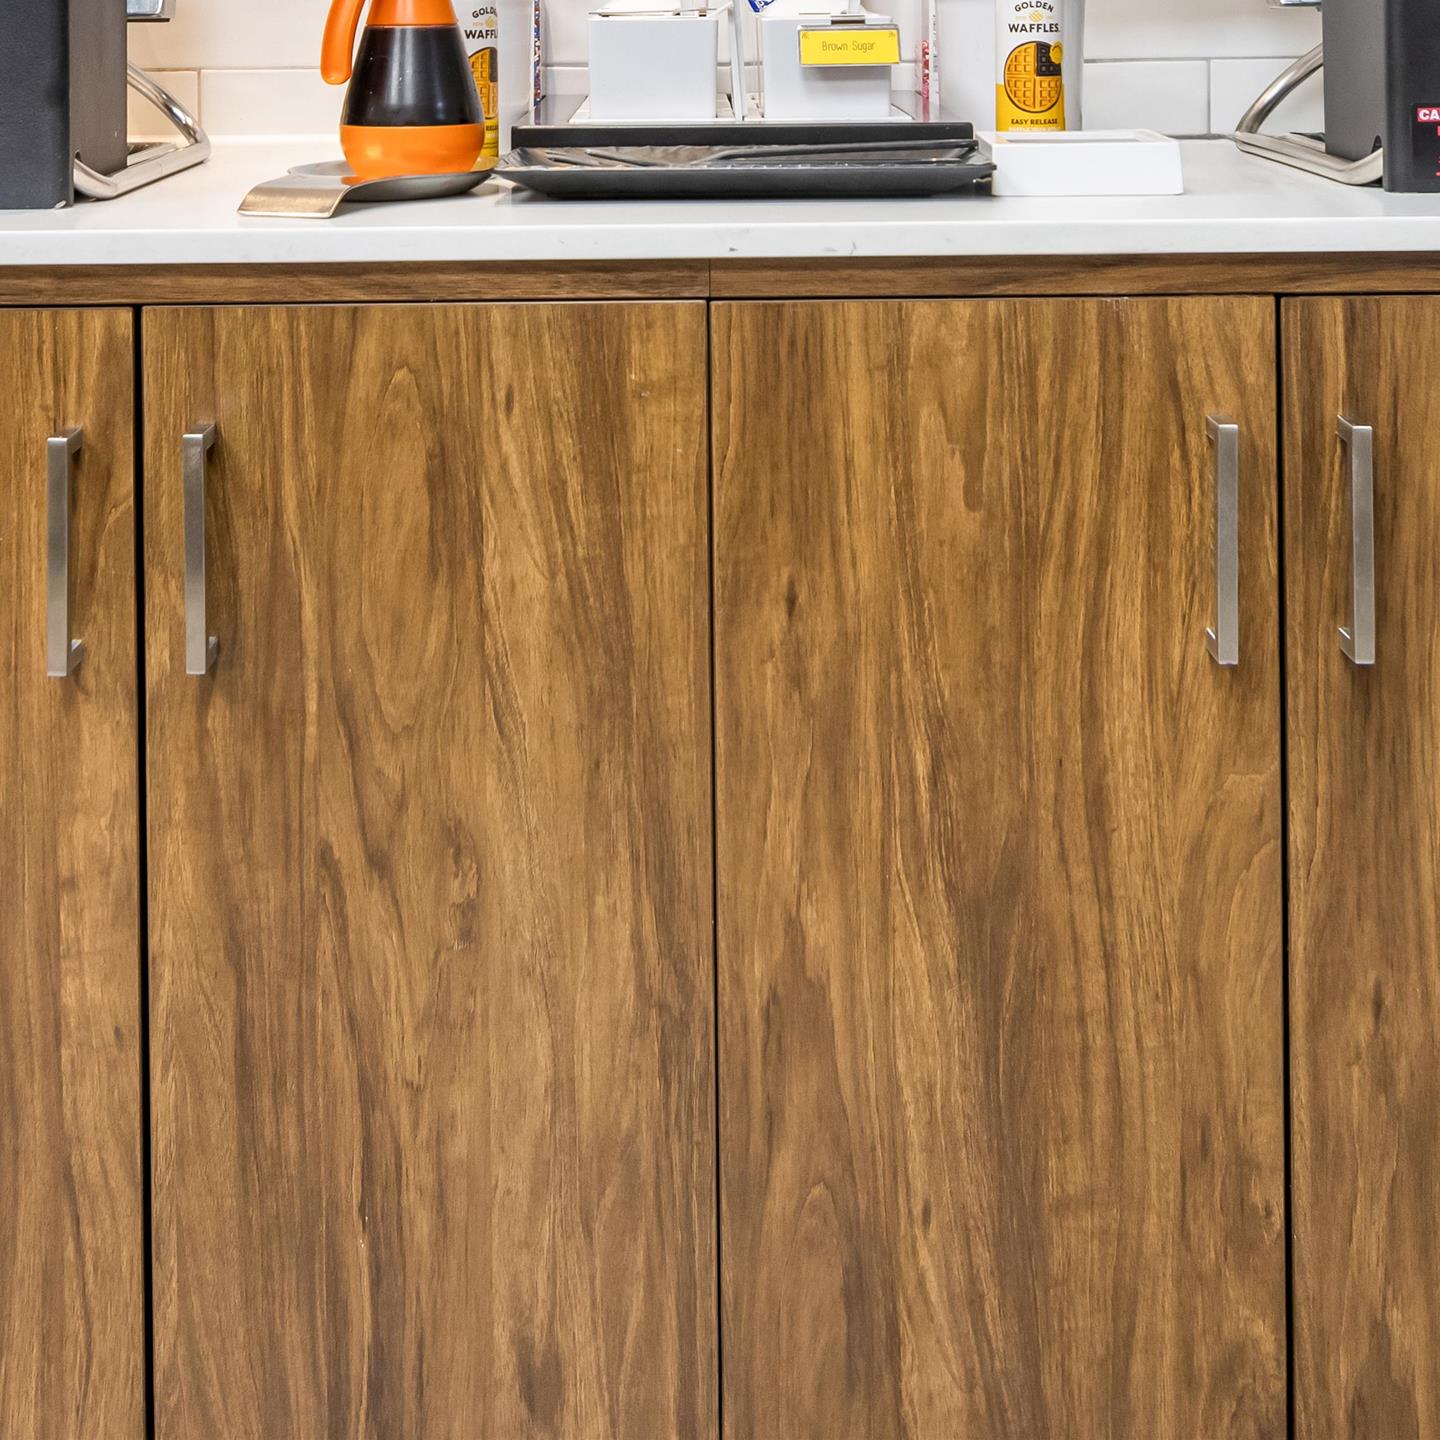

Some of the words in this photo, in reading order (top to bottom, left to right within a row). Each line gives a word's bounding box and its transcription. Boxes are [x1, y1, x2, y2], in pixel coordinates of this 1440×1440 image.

[1014, 1, 1054, 12] GOLDEN
[822, 41, 848, 51] Brown
[852, 41, 876, 53] Sugar
